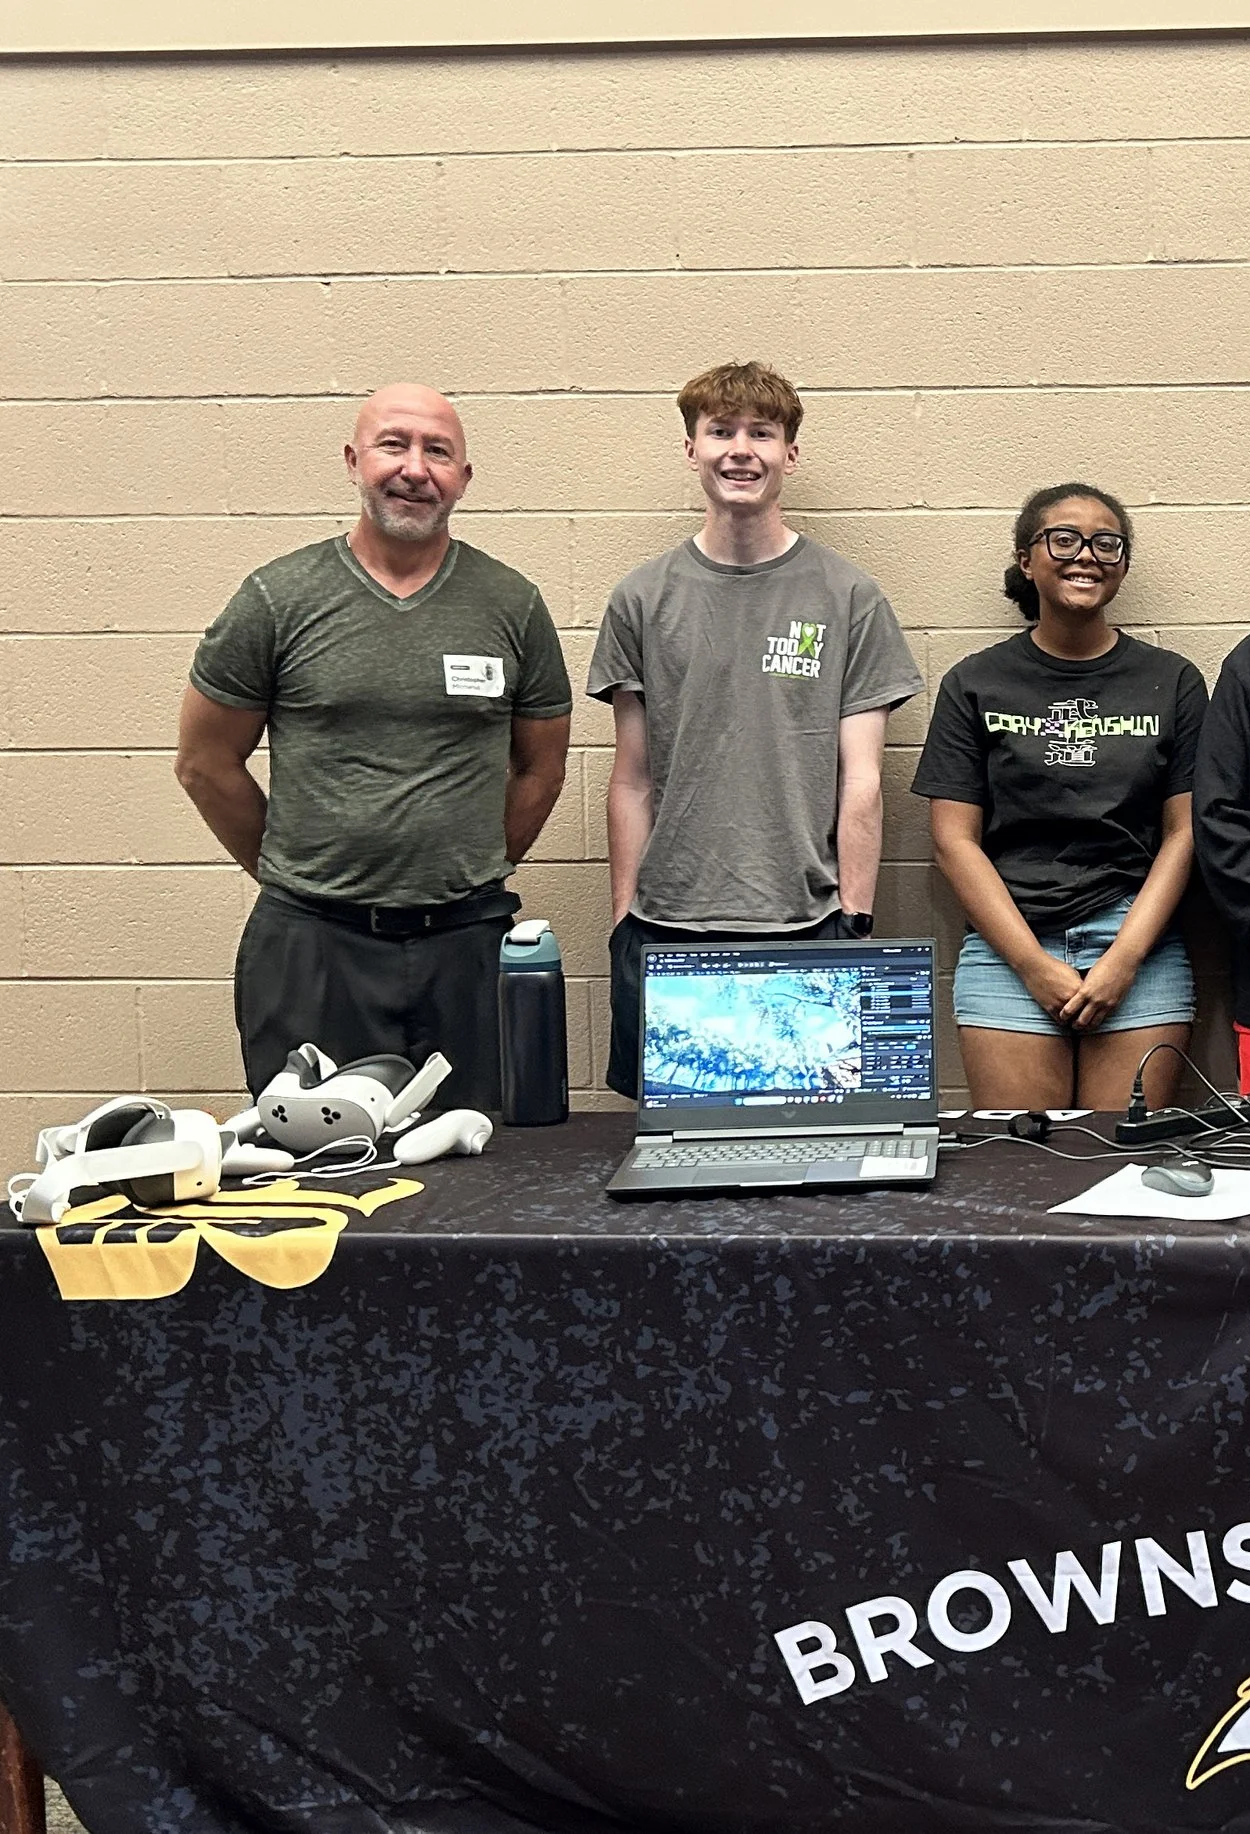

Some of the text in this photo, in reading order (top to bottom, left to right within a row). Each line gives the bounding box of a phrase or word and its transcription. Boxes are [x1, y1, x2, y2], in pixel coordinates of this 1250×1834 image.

[789, 620, 827, 642] NOT
[767, 636, 824, 659] TODAY
[762, 654, 821, 678] CANCER
